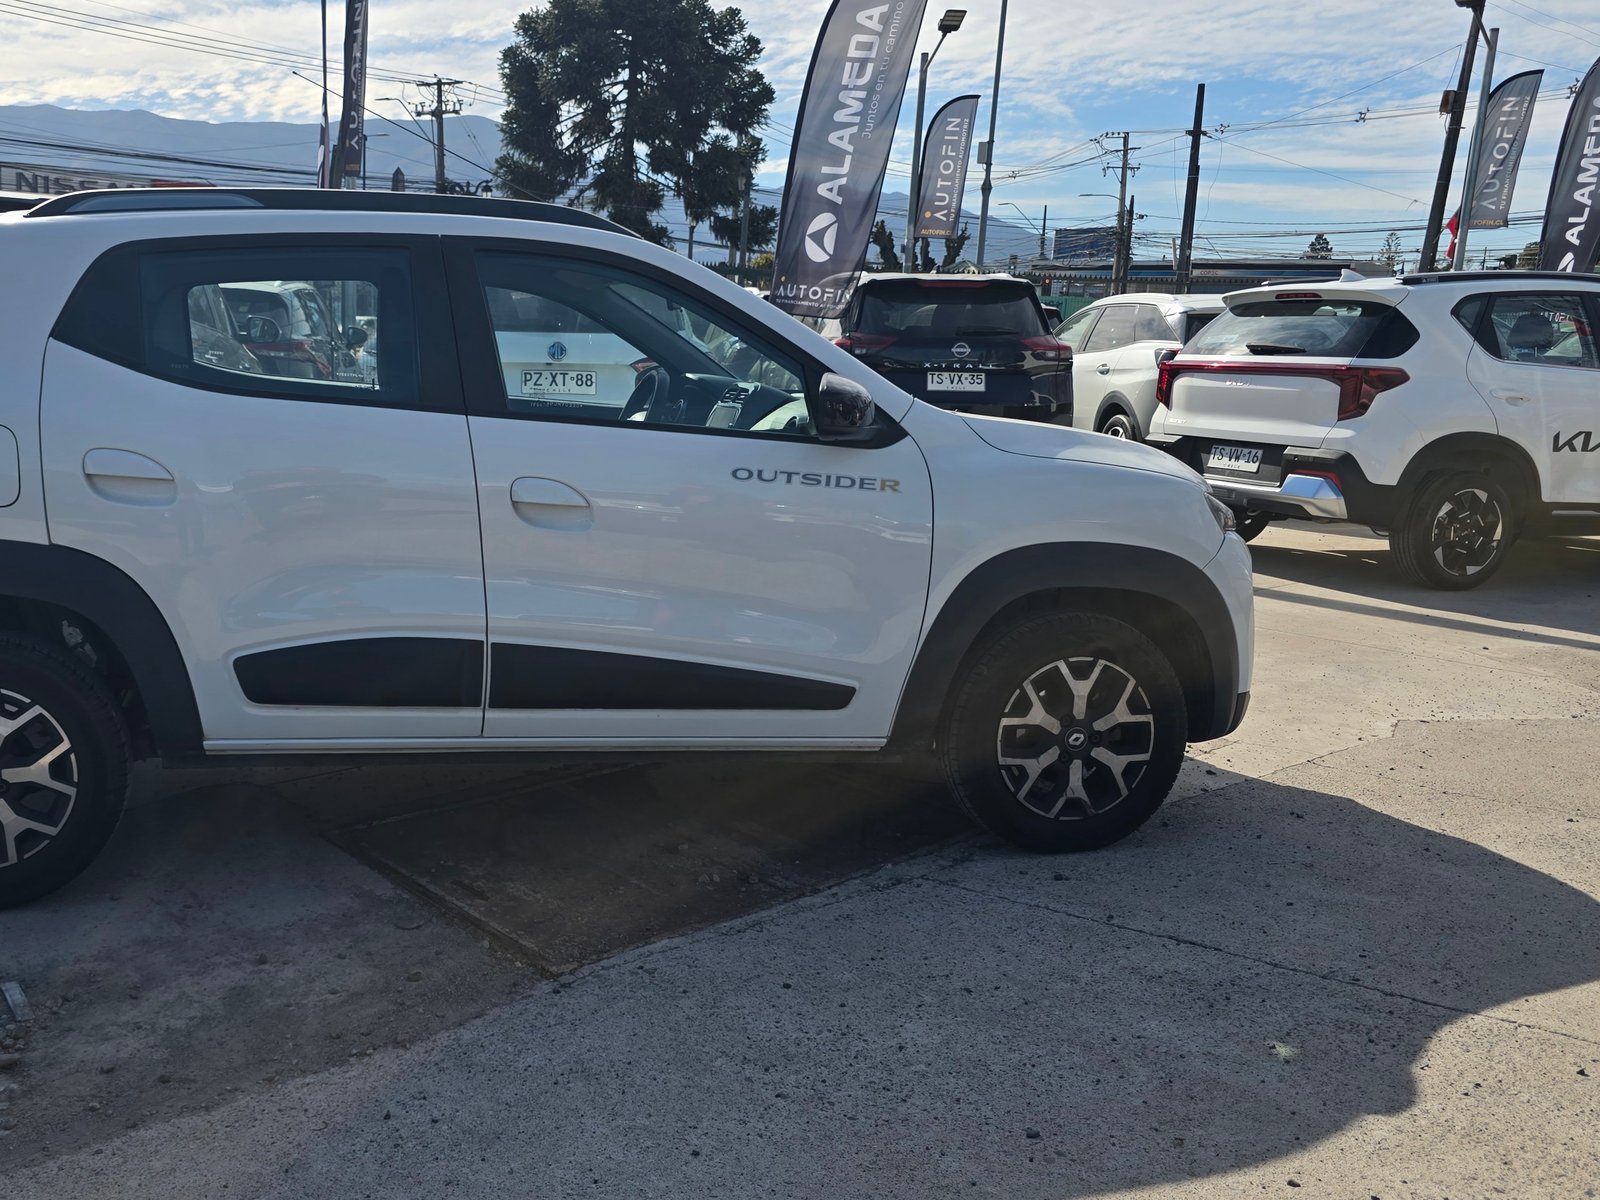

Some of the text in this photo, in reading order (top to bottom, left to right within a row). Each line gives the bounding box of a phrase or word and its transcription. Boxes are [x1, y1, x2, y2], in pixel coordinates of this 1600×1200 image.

[817, 3, 890, 205] ALAMEDA
[862, 1, 905, 140] Juntos en tu camino
[933, 118, 961, 221] AUTOFIN
[959, 118, 969, 158] AUTOMOTRIZ
[1480, 97, 1521, 210] AUTOFIN
[15, 171, 148, 195] NISS
[548, 342, 567, 360] MG
[731, 467, 902, 492] OUTSIDER
